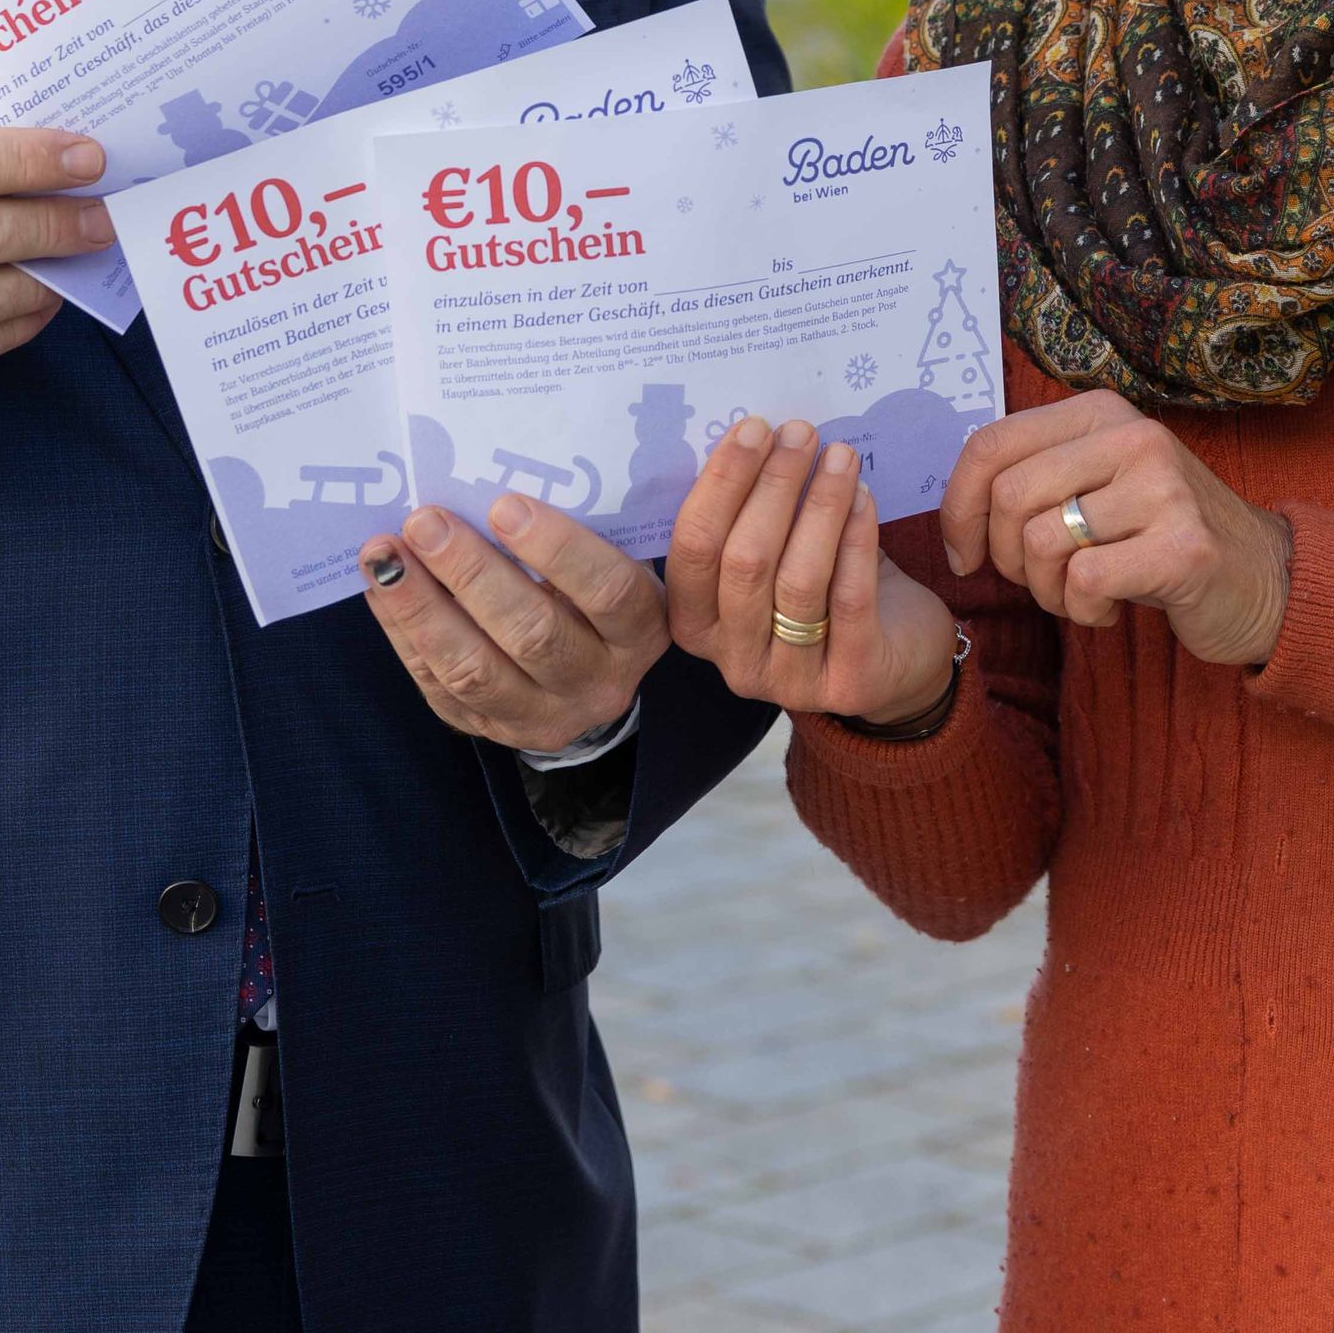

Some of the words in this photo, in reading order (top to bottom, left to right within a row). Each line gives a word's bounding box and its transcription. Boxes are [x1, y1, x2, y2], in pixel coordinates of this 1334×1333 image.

[11, 73, 29, 89] in
[30, 55, 52, 78] der
[54, 35, 85, 62] Zeit
[85, 18, 115, 42] von
[11, 73, 71, 119] Badener
[73, 31, 143, 78] Geschäft,
[143, 12, 170, 35] das
[377, 54, 436, 96] 595/1
[782, 134, 916, 187] Baden
[793, 189, 813, 204] bei
[815, 185, 849, 199] Wien
[425, 221, 646, 272] Gutschein
[433, 290, 522, 309] einzulösen
[527, 288, 543, 303] in
[548, 285, 577, 301] der
[580, 281, 612, 298] Zeit
[618, 281, 649, 295] von
[772, 257, 794, 274] bis
[436, 319, 452, 334] in
[456, 317, 507, 333] einem
[513, 311, 584, 329] Badener
[588, 300, 666, 322] Geschäft,
[670, 297, 699, 313] das
[703, 291, 754, 309] diesen
[758, 274, 832, 300] Gutschein
[836, 259, 914, 286] anerkennt.
[204, 309, 289, 349] einzulösen
[292, 302, 309, 317] in
[312, 291, 339, 310] der
[342, 278, 374, 299] Zeit
[524, 339, 557, 349] dieses
[559, 335, 604, 347] Betrages
[605, 329, 629, 342] wird
[630, 329, 647, 339] die
[648, 319, 730, 337] Geschäftsleitung
[773, 306, 803, 319] diesen
[804, 297, 849, 313] Gutschein
[850, 292, 874, 303] unter
[875, 284, 909, 299] Angabe
[551, 351, 569, 362] der
[571, 347, 621, 361] Abteilung
[622, 339, 680, 355] Gesundheit
[681, 335, 701, 348] und
[703, 331, 744, 345] Soziales
[744, 328, 761, 338] der
[762, 314, 830, 336] Stadtgemeinde
[832, 309, 860, 322] Baden
[861, 306, 876, 318] per
[877, 300, 897, 313] Post
[211, 357, 229, 372] in
[232, 339, 282, 365] einem
[284, 312, 352, 346] Badener
[331, 355, 348, 367] der
[553, 366, 572, 377] der
[573, 364, 594, 375] Zeit
[595, 363, 616, 373] von
[665, 353, 685, 365] Uhr
[729, 345, 745, 355] bis
[747, 336, 784, 353] Freitag)
[786, 336, 799, 346] im
